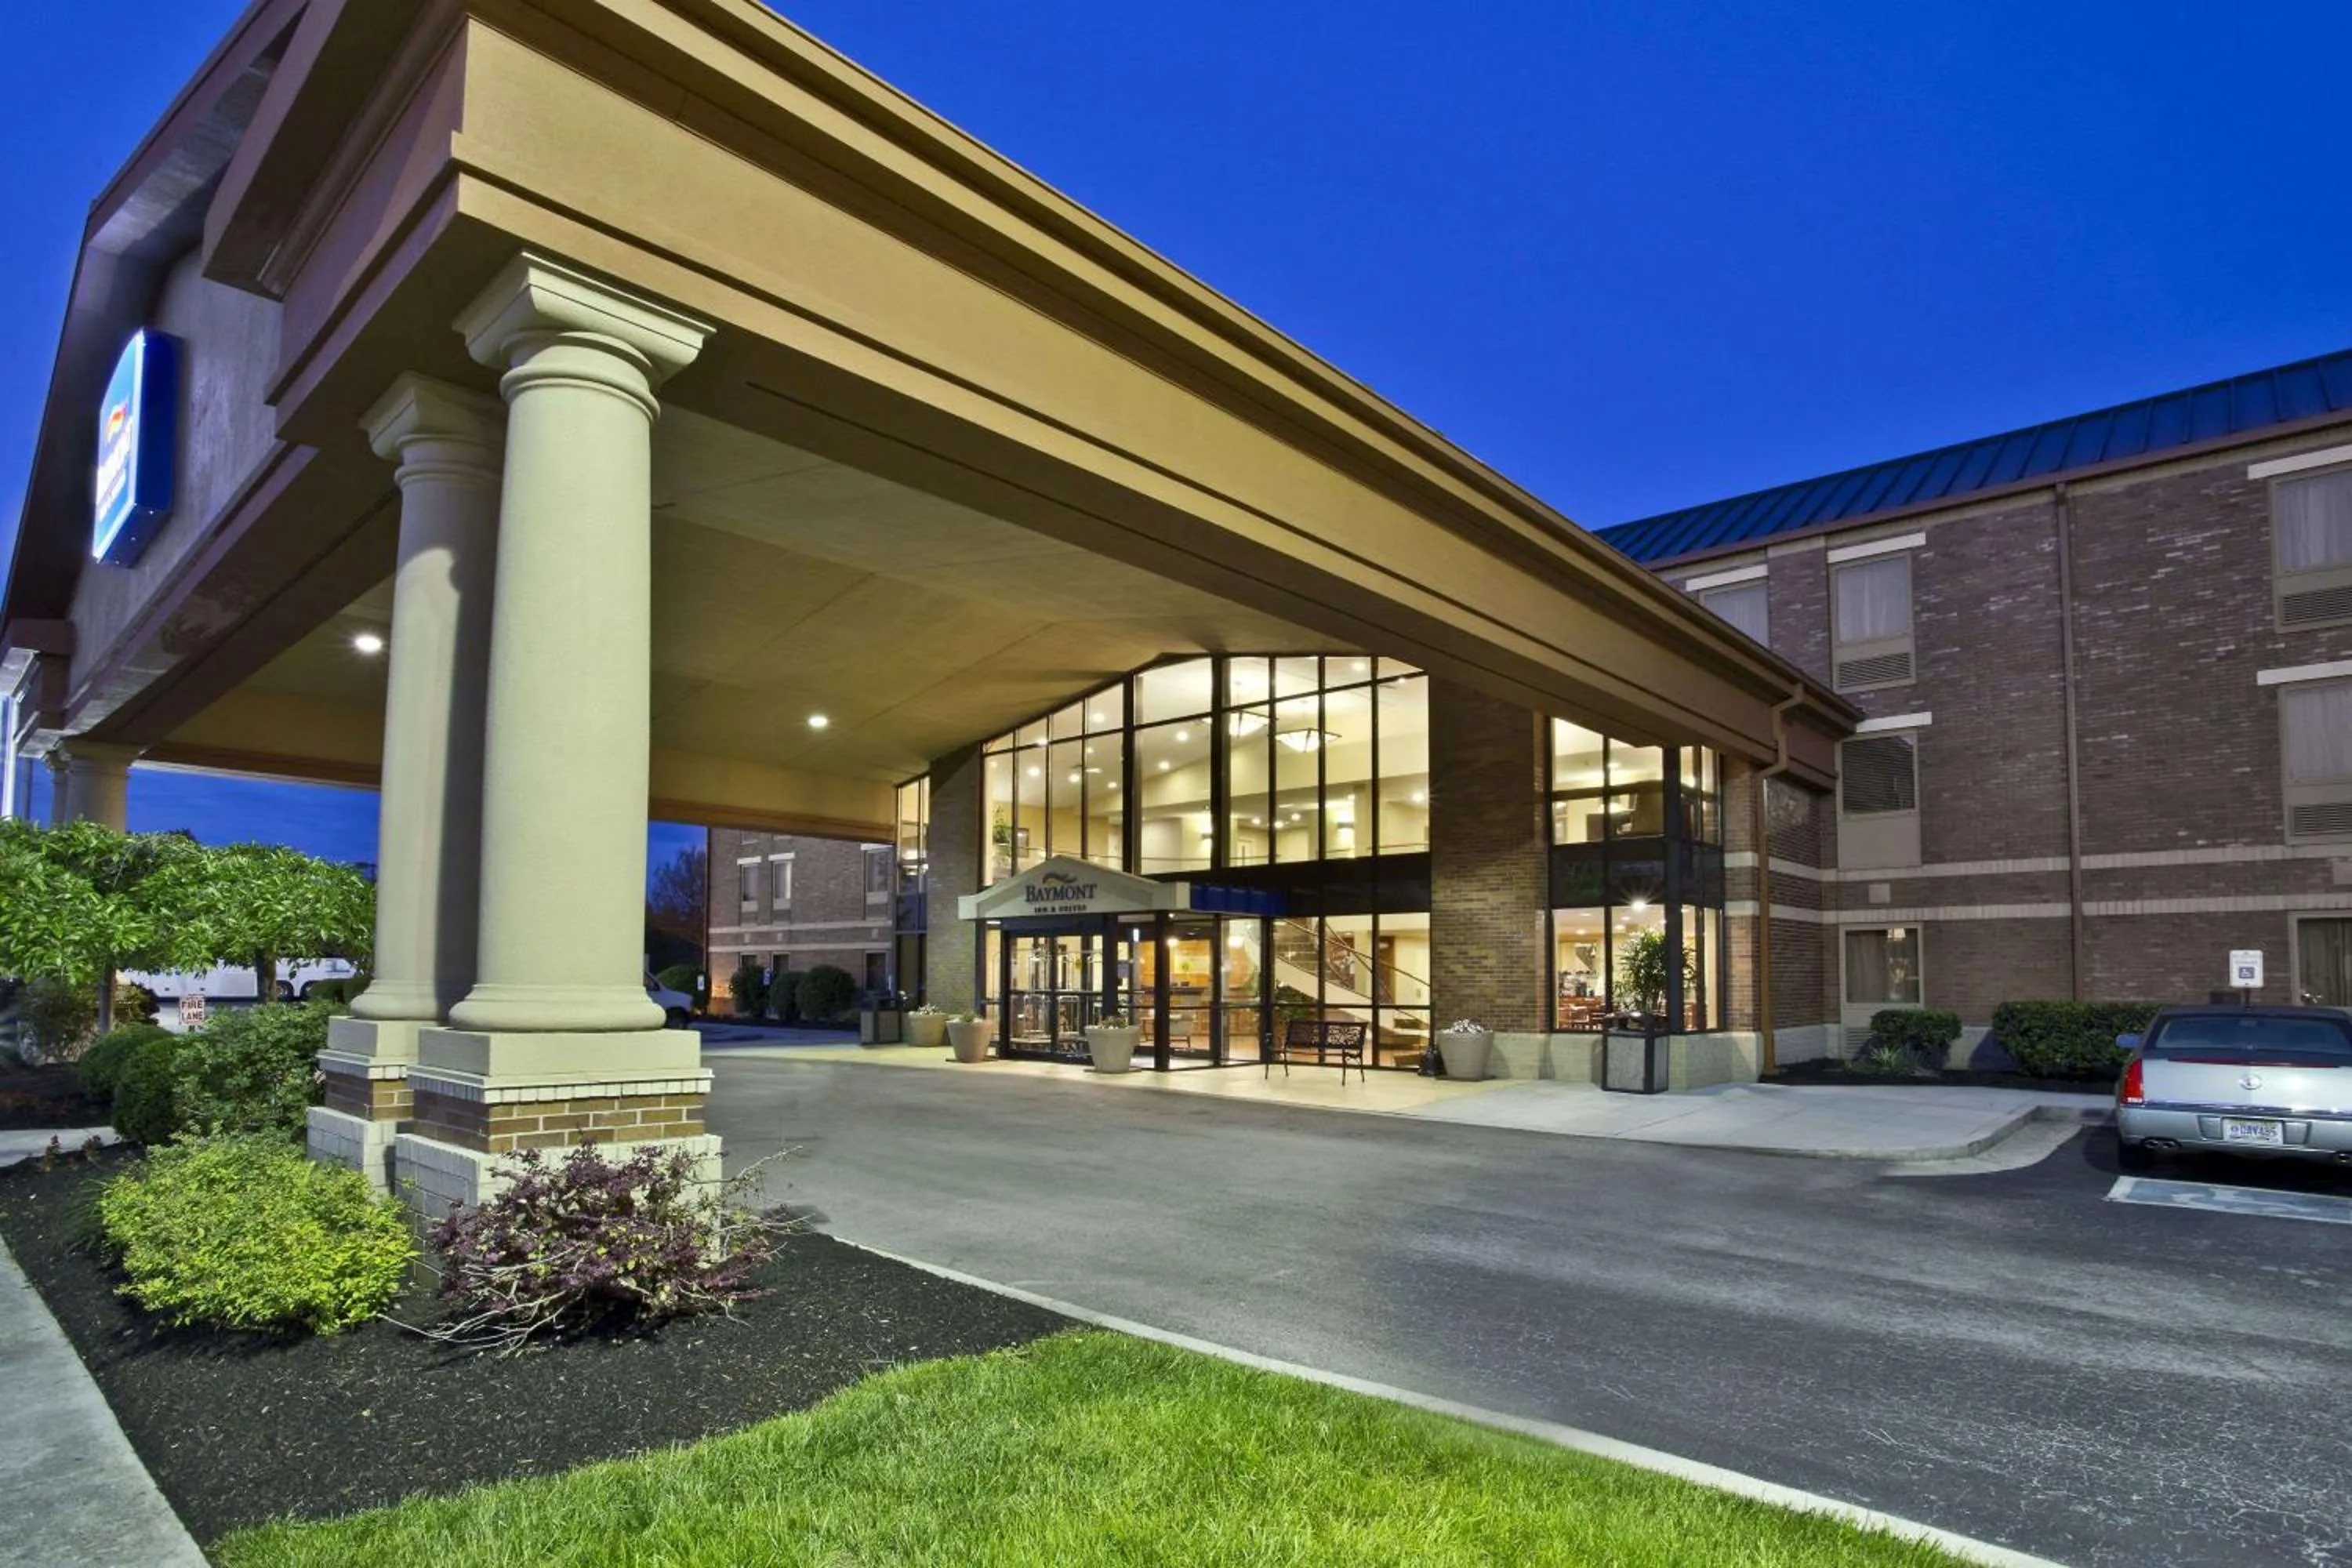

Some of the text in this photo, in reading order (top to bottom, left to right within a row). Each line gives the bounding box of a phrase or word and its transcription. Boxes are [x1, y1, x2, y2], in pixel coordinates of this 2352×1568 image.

[1025, 884, 1098, 902] BAYMONT
[181, 1000, 203, 1009] FIRE
[181, 1011, 203, 1021] LANE
